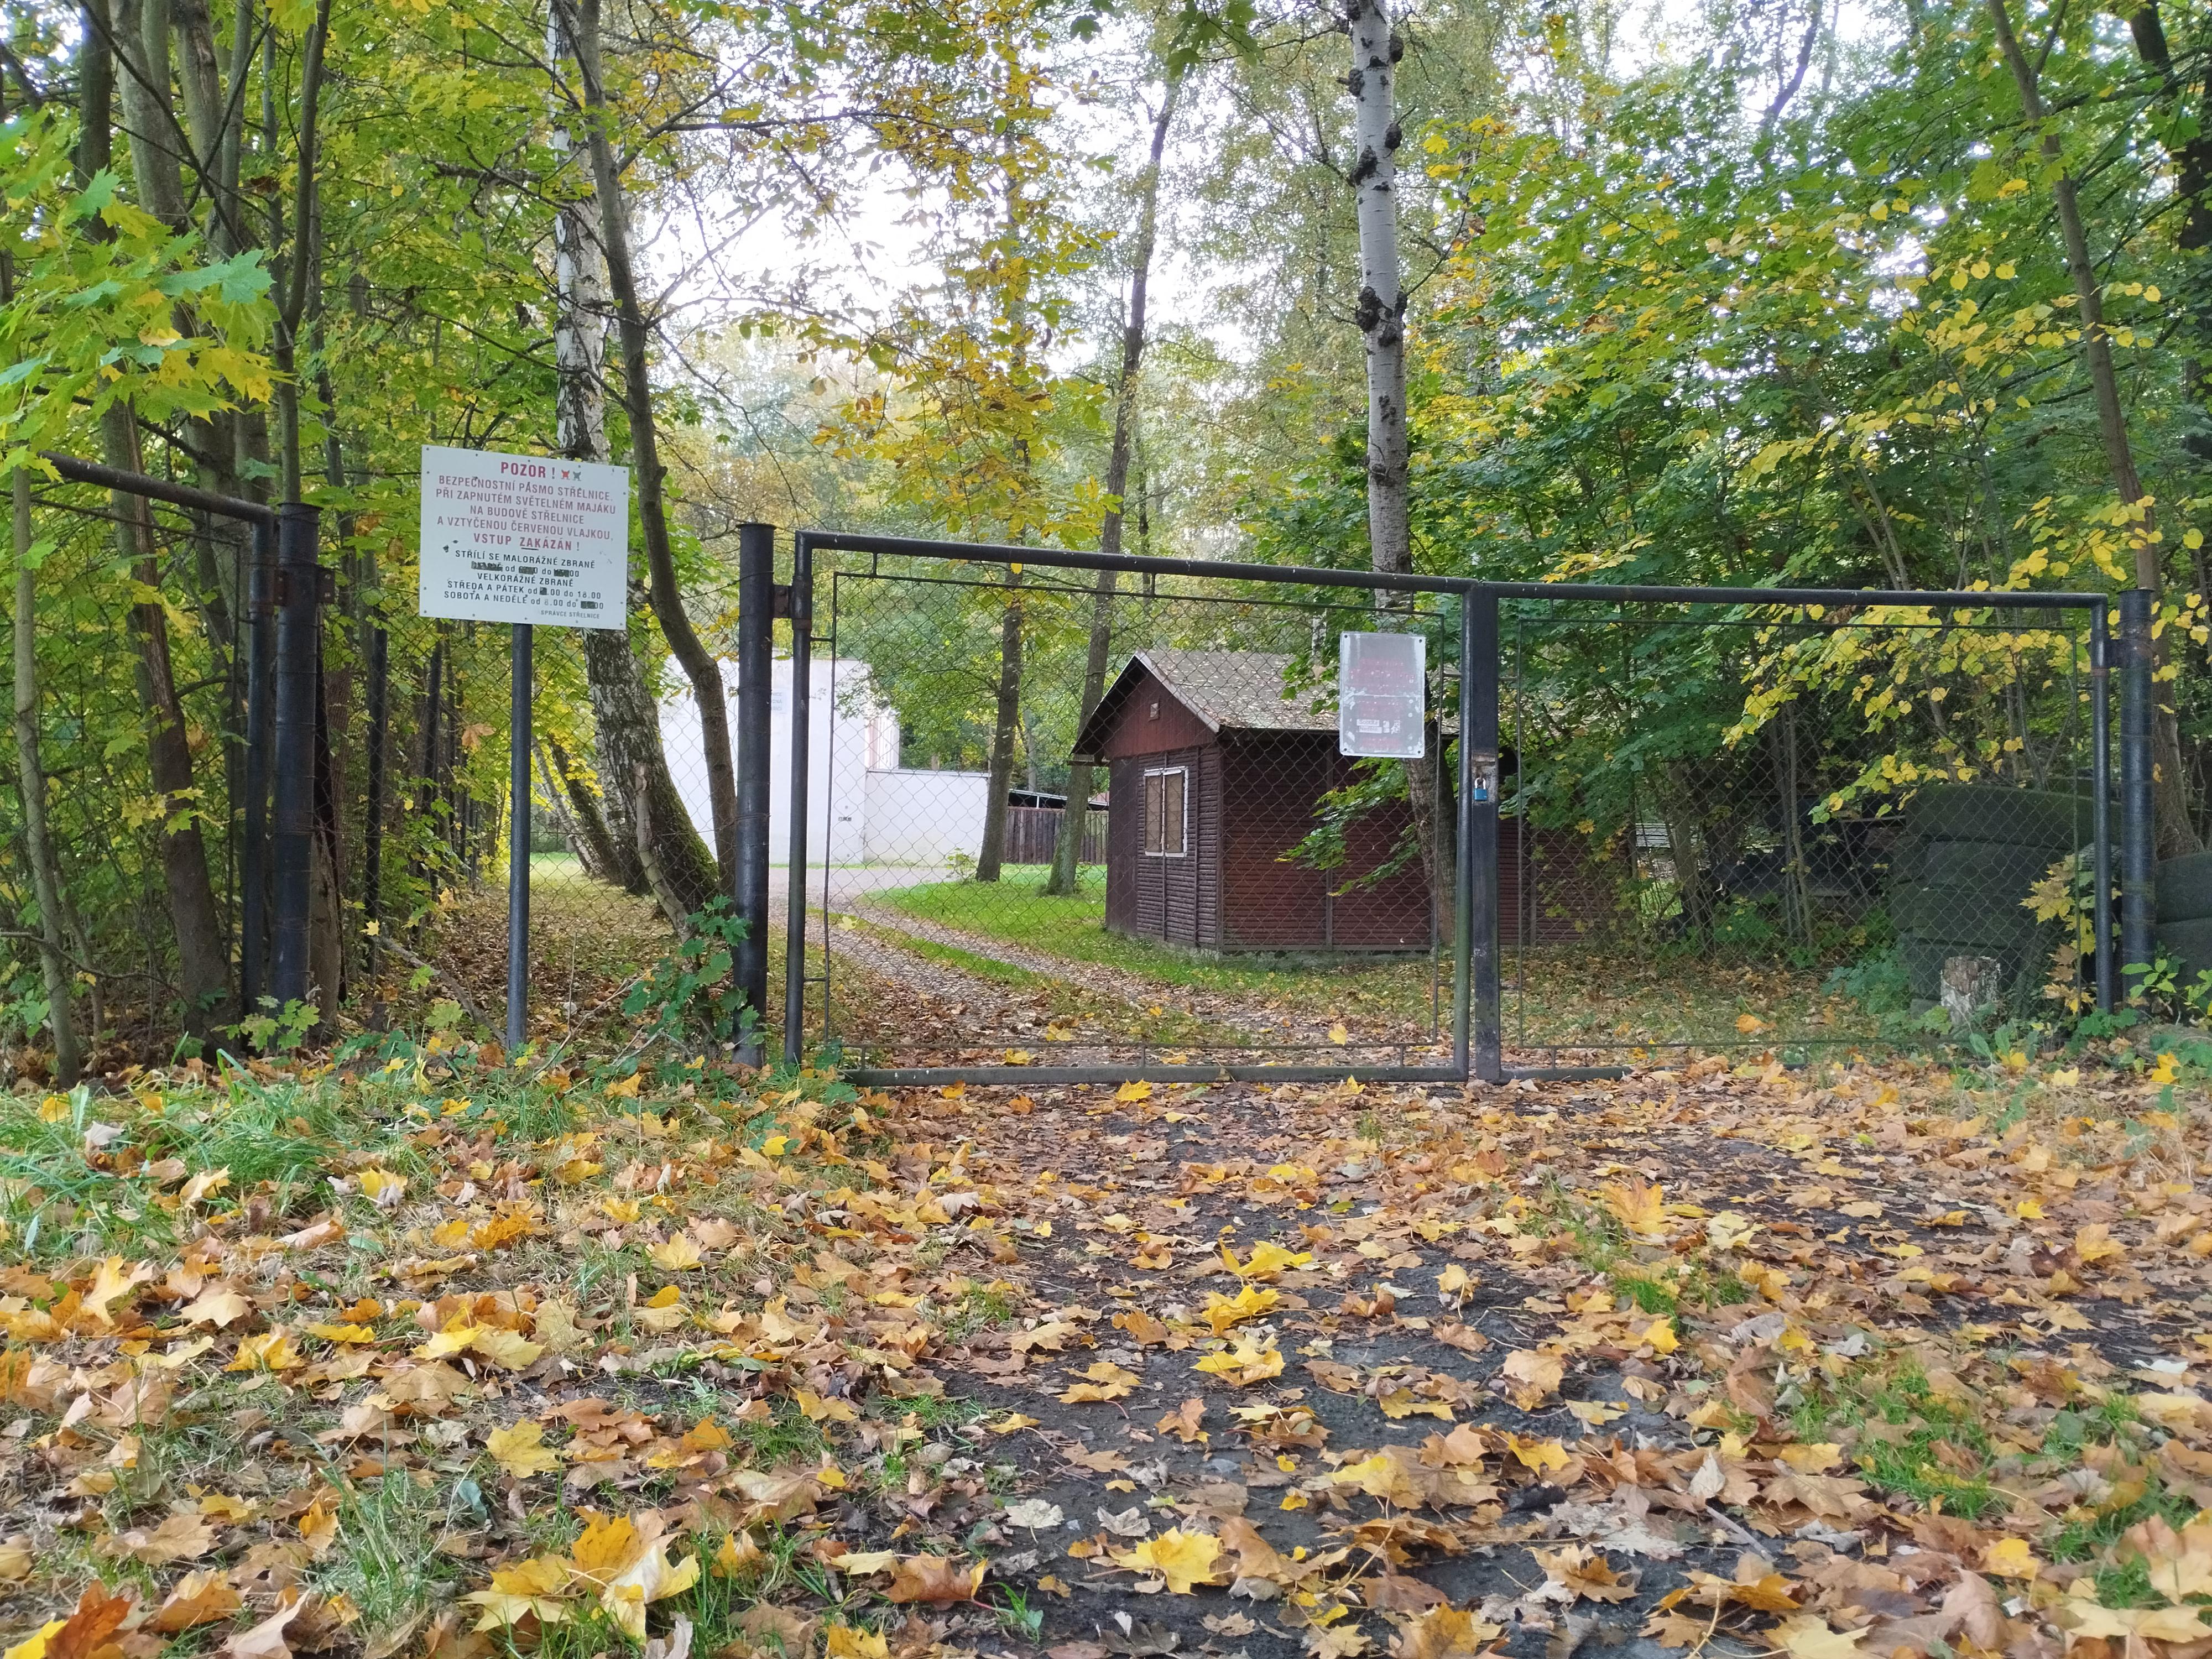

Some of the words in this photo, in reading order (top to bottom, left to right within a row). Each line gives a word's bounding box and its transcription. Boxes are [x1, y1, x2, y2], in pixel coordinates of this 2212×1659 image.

[500, 461, 546, 478] POZOR
[552, 467, 555, 479] !
[439, 475, 516, 491] BEZPEČNOSTNÍ
[519, 482, 554, 495] PÁSMO
[436, 487, 453, 499] PŘI
[457, 490, 512, 504] ZAPNUTÉM
[515, 495, 573, 510] SVĚTELNÉM
[577, 502, 615, 514] MAJÁKU
[470, 505, 483, 515] NA
[487, 507, 528, 519] BUDOVĚ
[531, 510, 584, 524] STŘELNICE
[437, 516, 444, 525] A
[447, 517, 507, 530] VZTYČENOU
[511, 520, 564, 535] ČERVENOU
[567, 527, 613, 541] VLAJKOU,
[473, 533, 512, 545] VSTUP
[520, 536, 572, 550] ZAKÁZÁN
[576, 541, 580, 551] !
[455, 549, 486, 559] STŘÍLÍ
[503, 554, 558, 565] MALORÁŽNÉ
[561, 559, 595, 568] ZBRANĚ
[477, 573, 535, 584] VELKORÁŽNÉ
[444, 591, 480, 601] SOBOTA
[448, 580, 483, 590] STŘEDA
[496, 583, 524, 593] PÁTEK
[539, 587, 560, 596] .00
